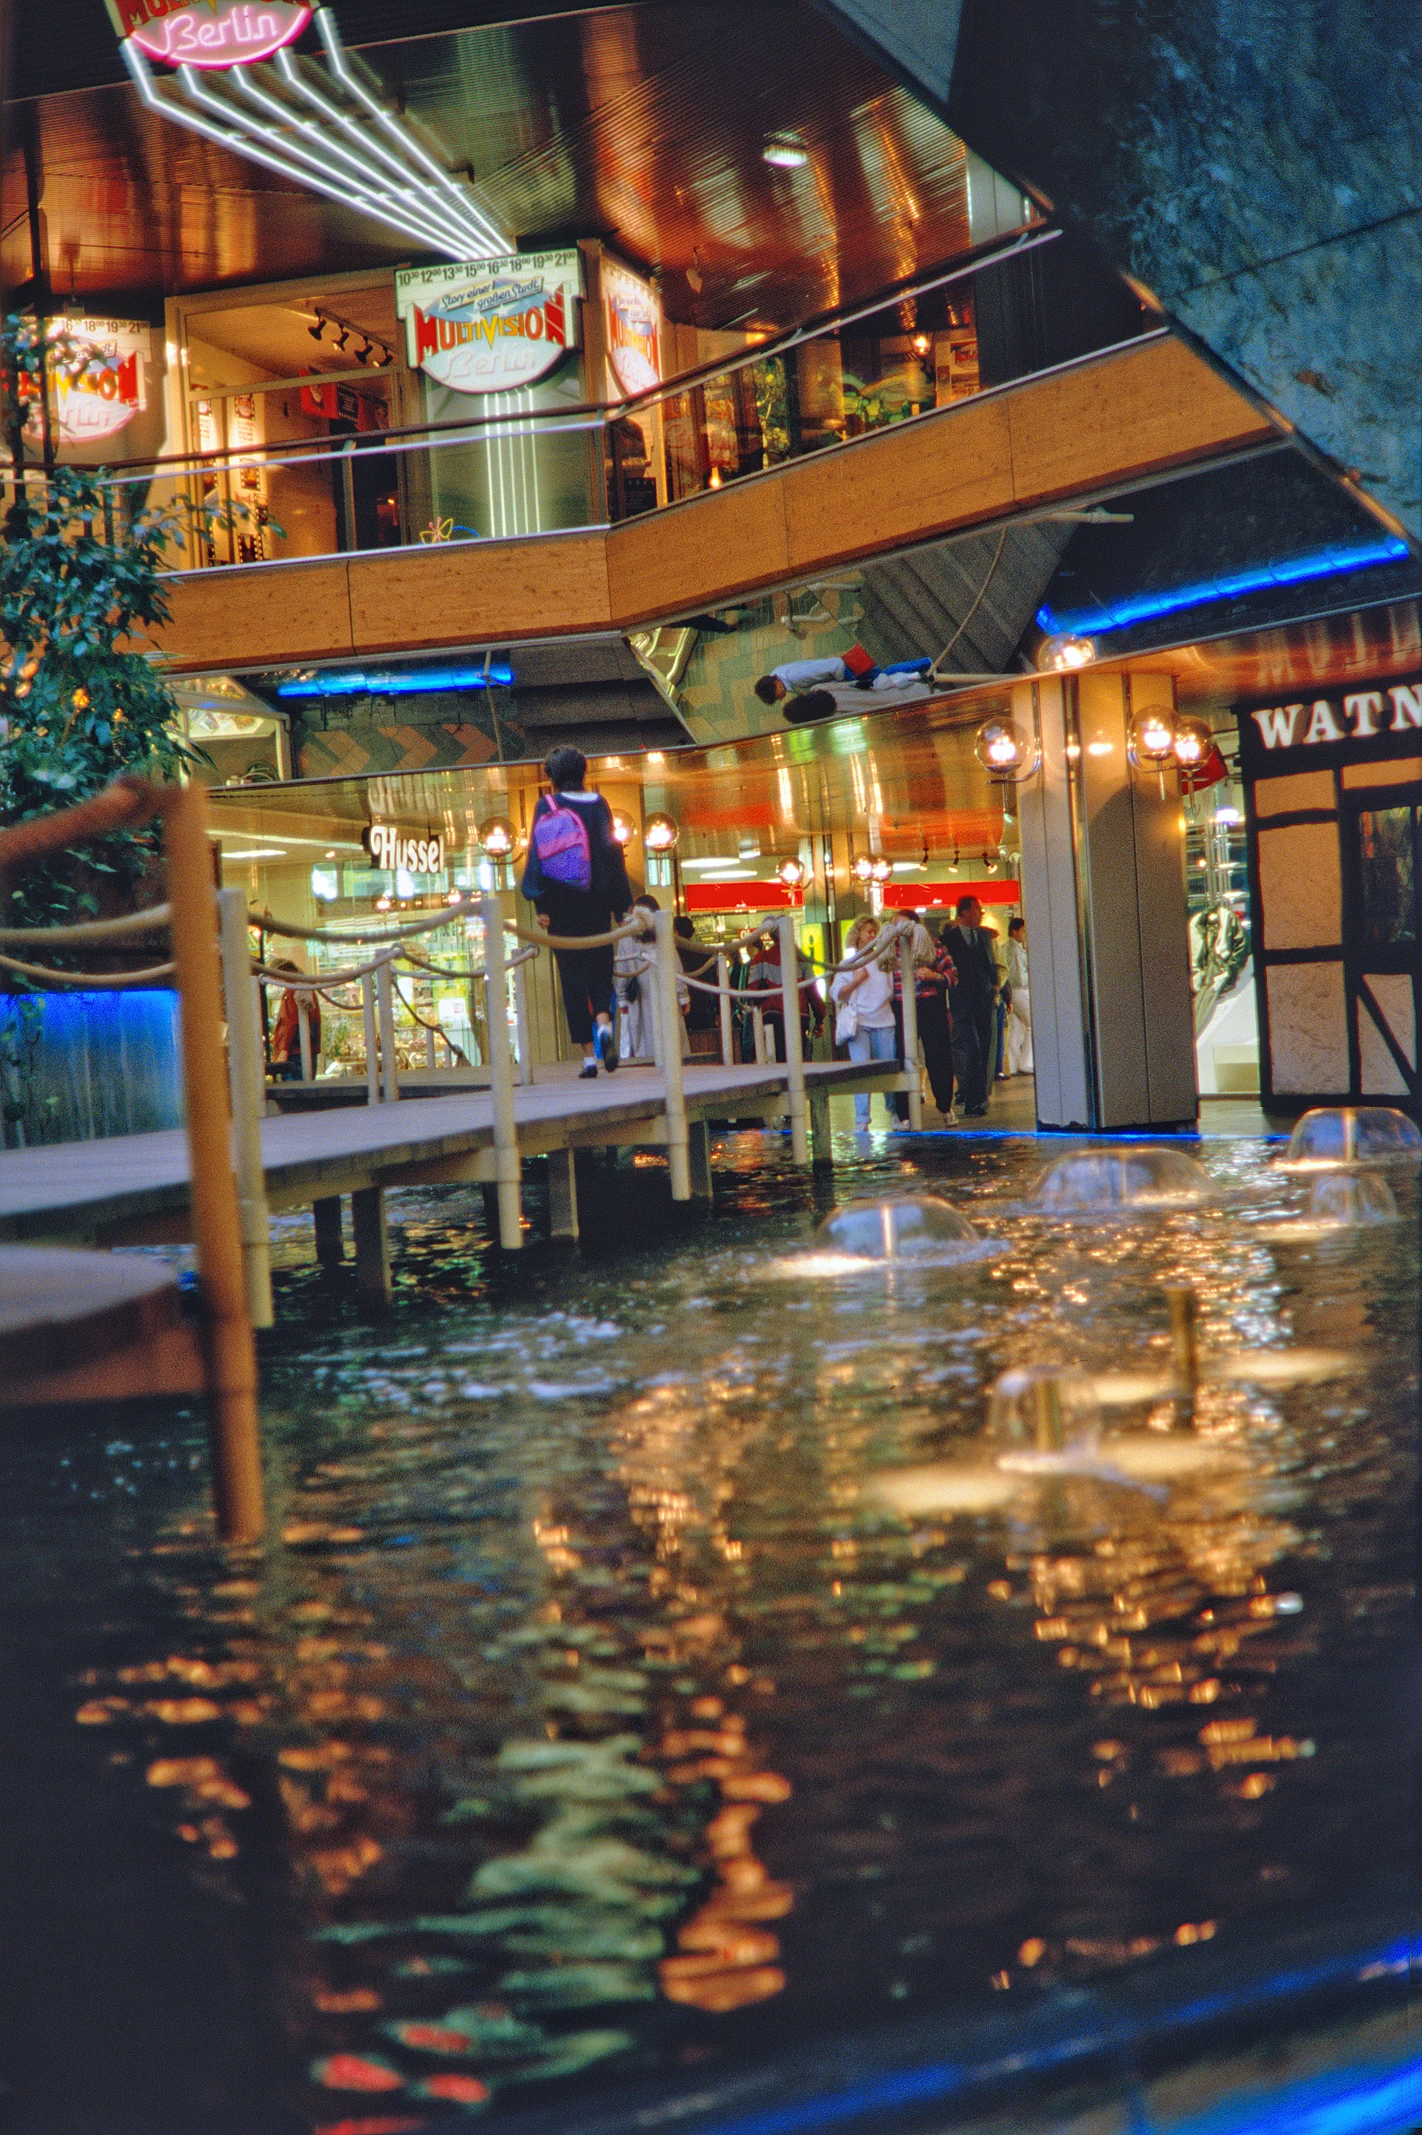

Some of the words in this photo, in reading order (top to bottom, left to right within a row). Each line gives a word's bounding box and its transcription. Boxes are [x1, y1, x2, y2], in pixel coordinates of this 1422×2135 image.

[164, 5, 277, 53] Berlin
[441, 290, 467, 308] Story
[467, 284, 491, 298] einer
[476, 290, 512, 310] großen
[511, 280, 539, 297] Stadt
[413, 283, 566, 366] MULTIVISION
[441, 346, 537, 382] Berlin
[1250, 683, 1422, 750] WATN
[369, 825, 445, 874] Hussel
